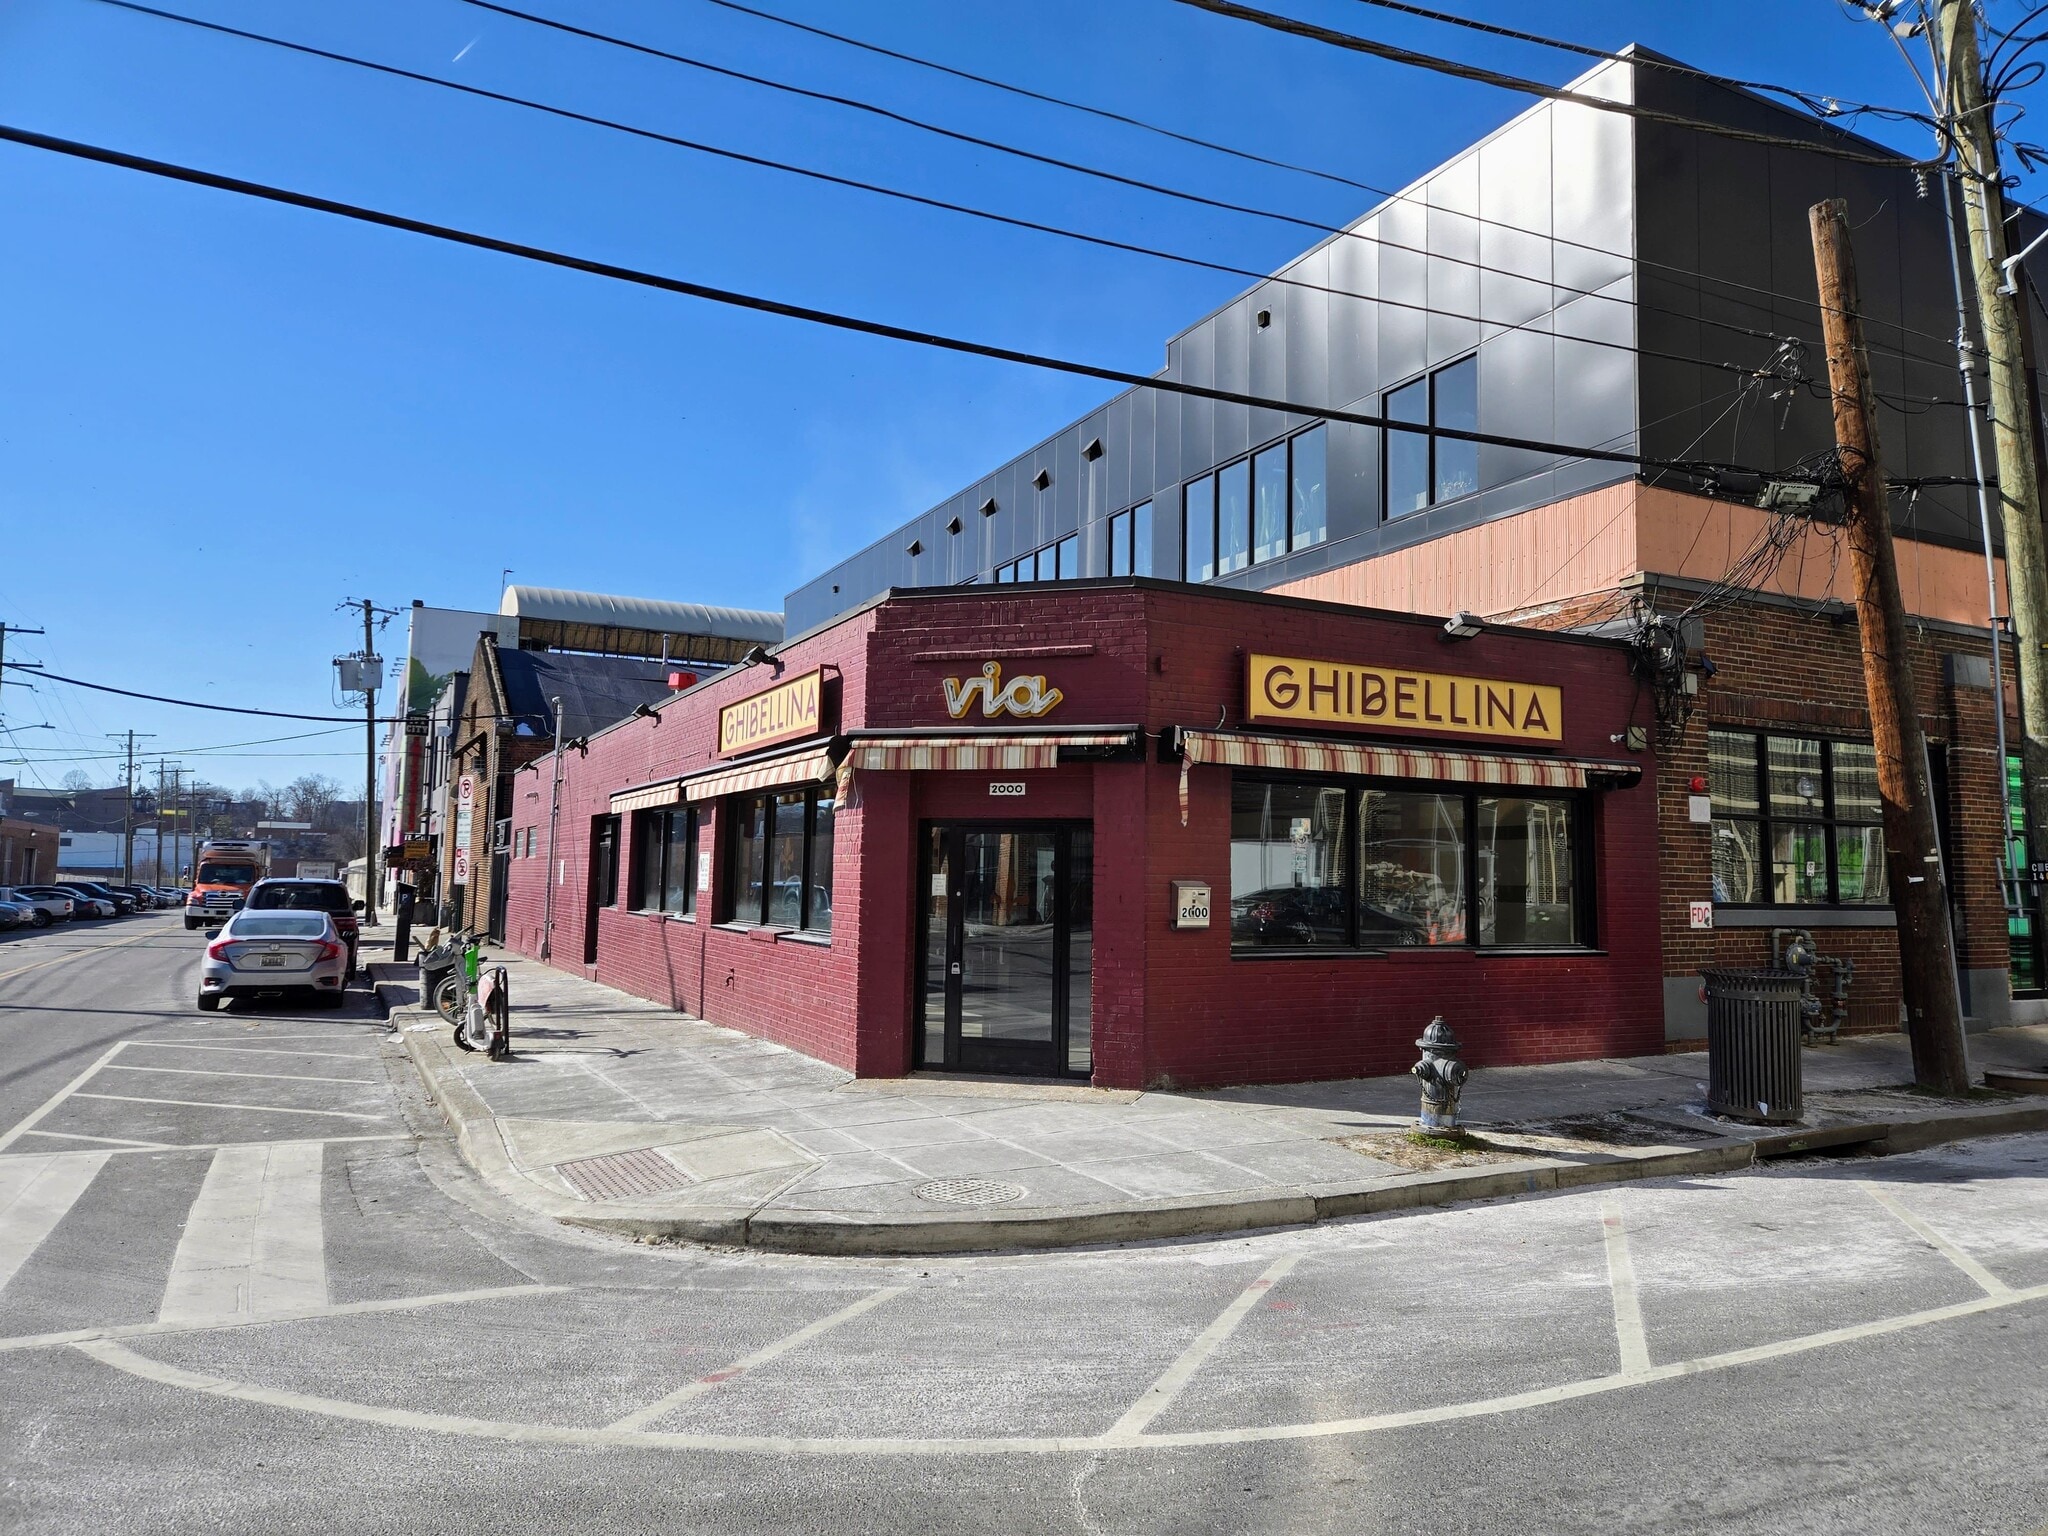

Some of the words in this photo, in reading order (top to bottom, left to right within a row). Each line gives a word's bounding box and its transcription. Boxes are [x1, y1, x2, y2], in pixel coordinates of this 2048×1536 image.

[943, 661, 1063, 718] via
[1264, 665, 1549, 732] GHIBELLINA
[406, 725, 428, 733] CITY
[725, 681, 816, 745] GHIBELLINA
[991, 785, 1023, 793] 2000
[1692, 906, 1710, 923] FDC
